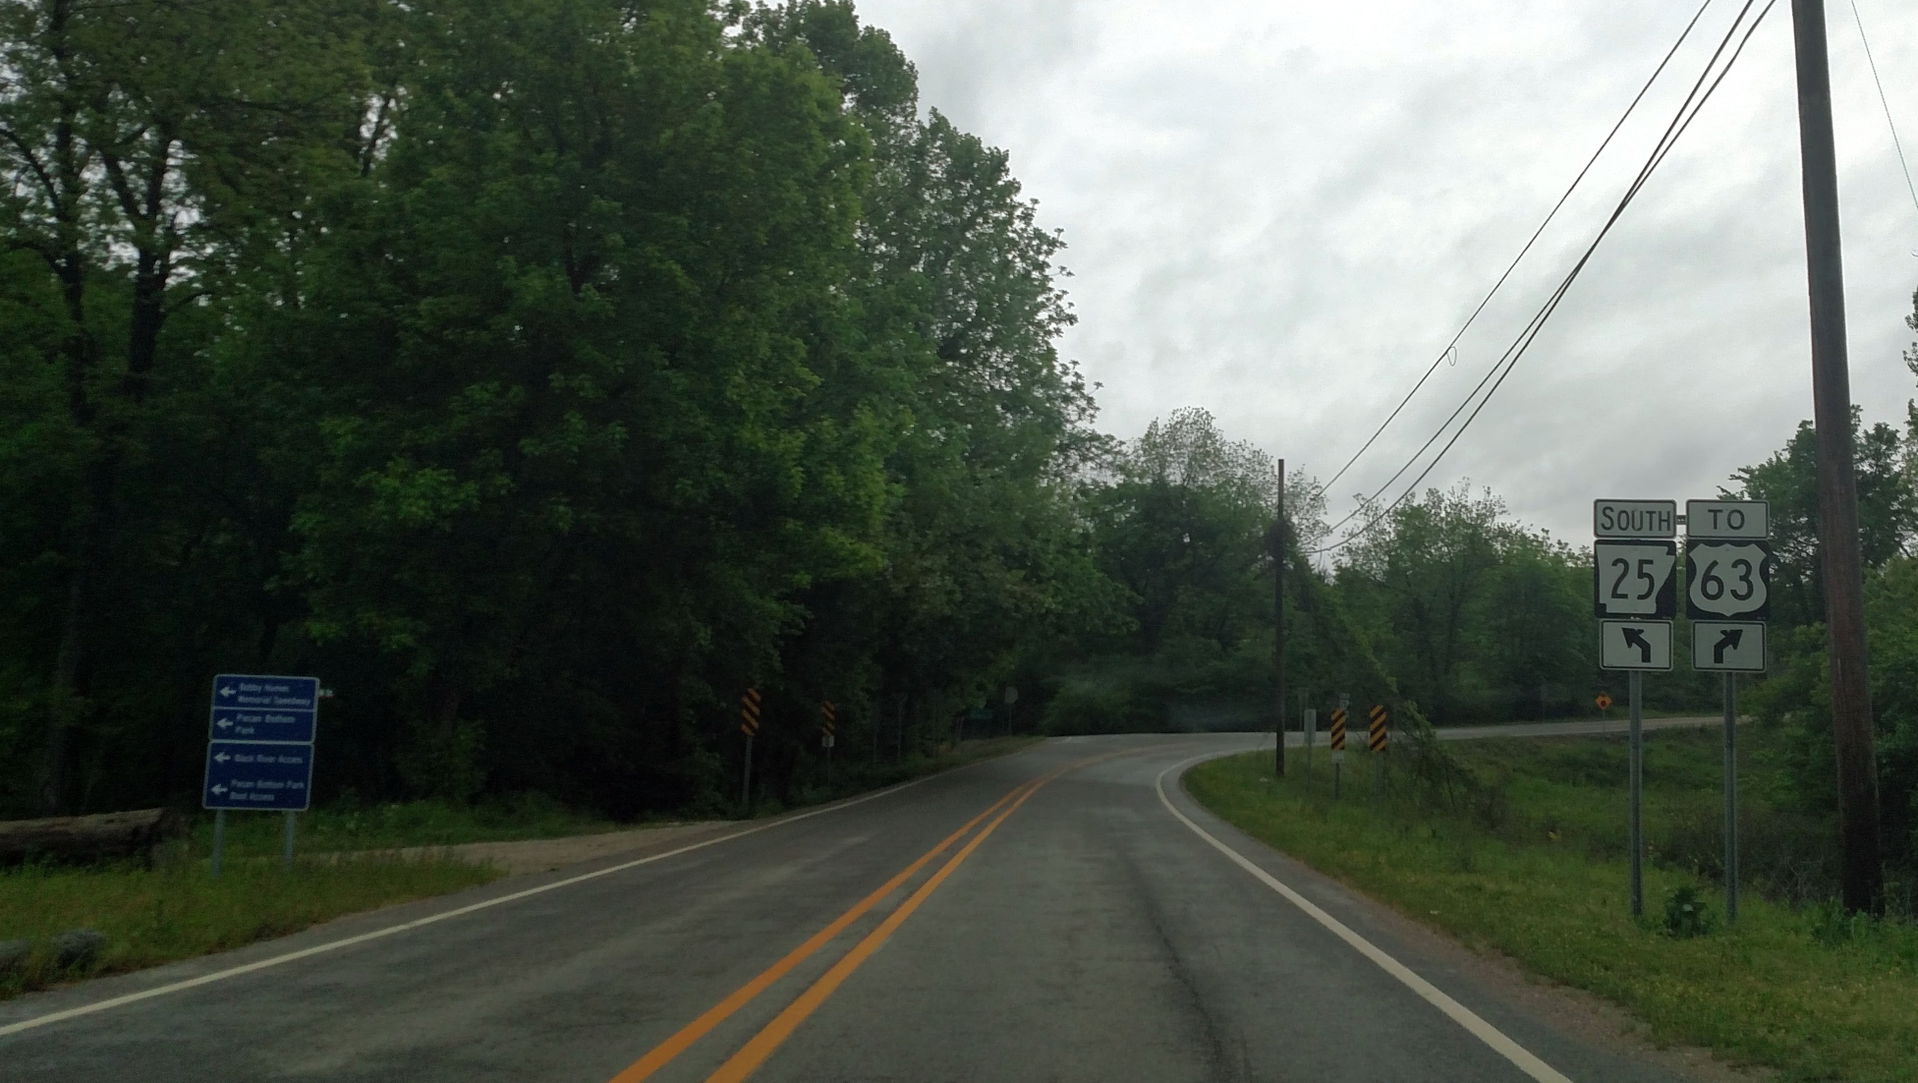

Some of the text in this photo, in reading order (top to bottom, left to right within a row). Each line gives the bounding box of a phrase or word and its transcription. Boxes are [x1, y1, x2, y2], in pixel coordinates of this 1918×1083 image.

[1601, 506, 1671, 531] SOUTH
[1708, 509, 1745, 530] TO
[1611, 558, 1655, 600] 25
[1701, 558, 1754, 601] 63
